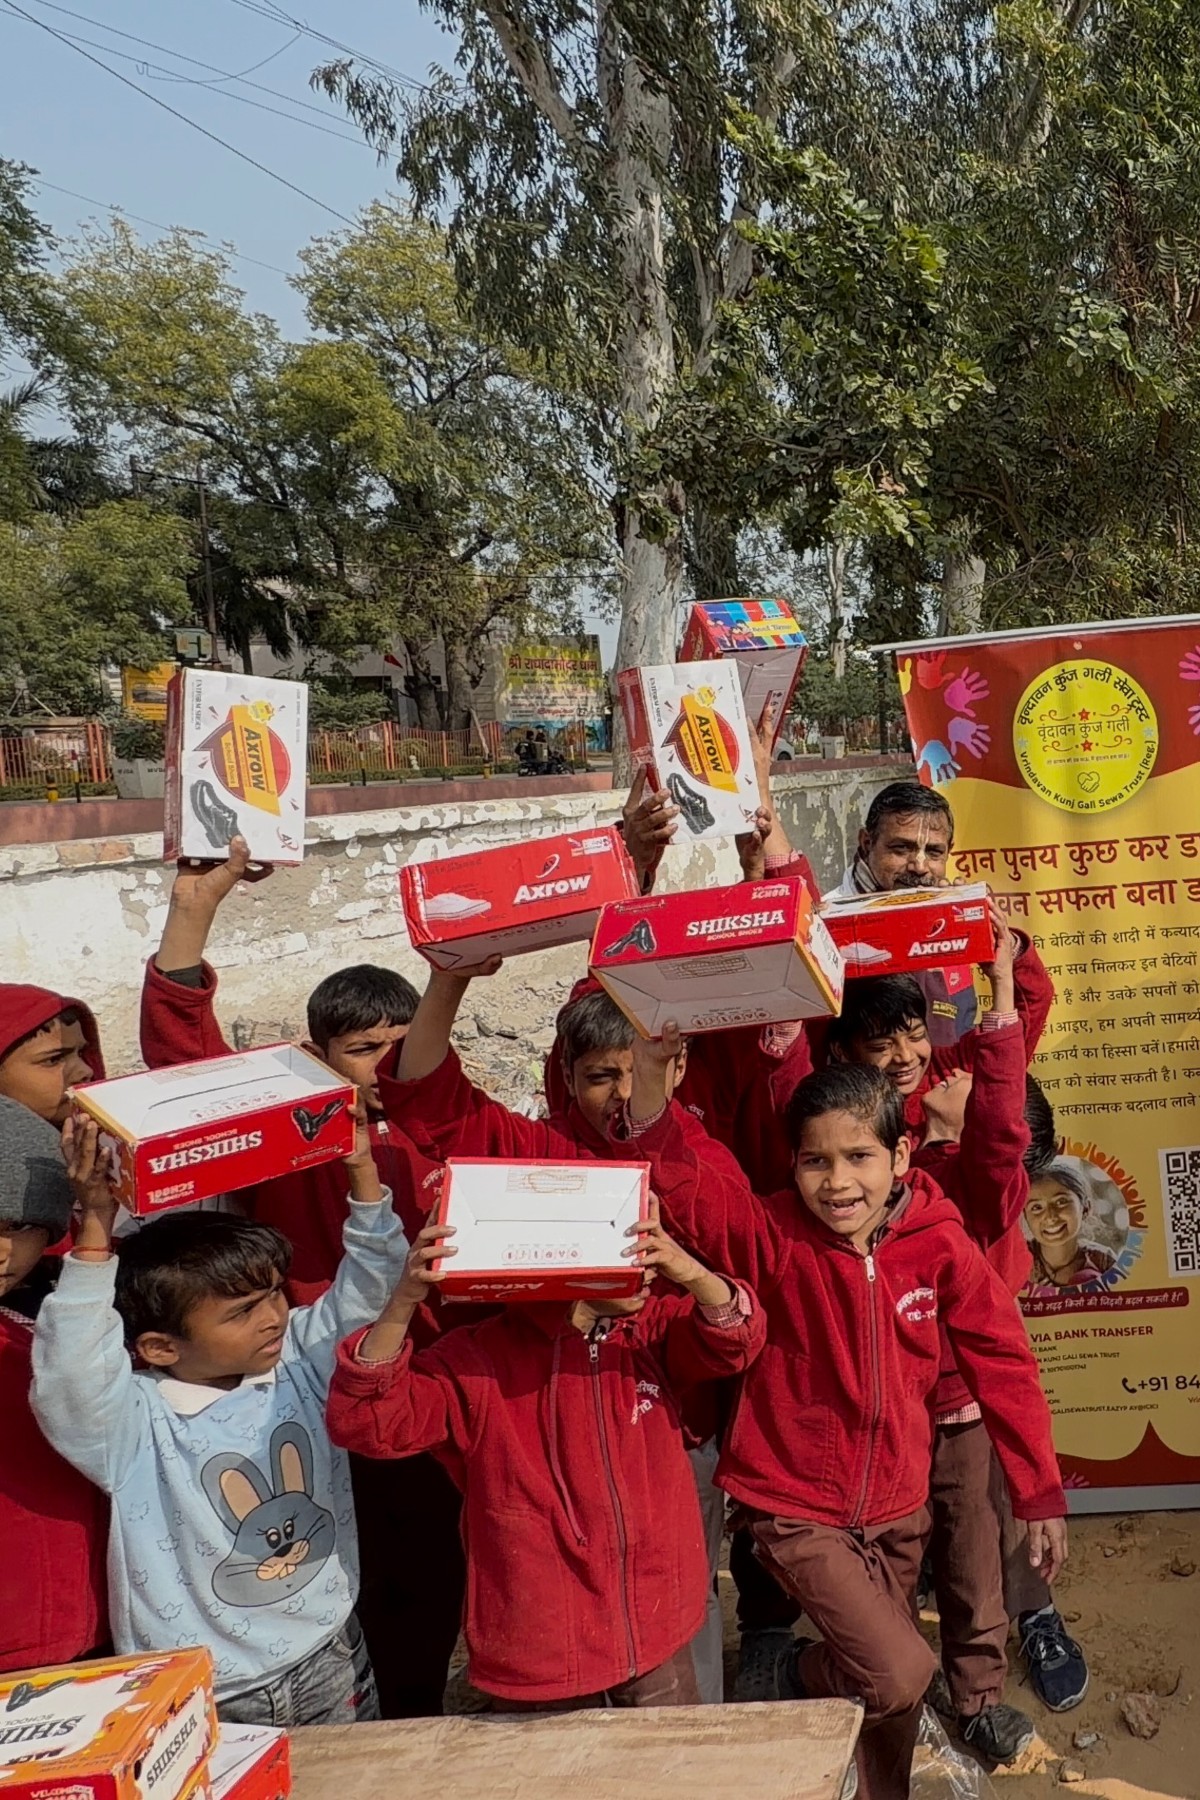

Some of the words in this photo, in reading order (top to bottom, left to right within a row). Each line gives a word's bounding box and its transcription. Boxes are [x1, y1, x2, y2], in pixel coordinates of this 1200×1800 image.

[1053, 668, 1079, 692] कुंज
[1083, 667, 1113, 684] गली
[1113, 676, 1136, 700] सेवा
[1037, 723, 1076, 742] वृंदावन
[1079, 721, 1103, 739] कुंज
[1106, 715, 1130, 733] गली
[695, 714, 723, 773] Axrow
[1020, 751, 1053, 797] Vrindavan
[1053, 792, 1075, 809] Kunj
[1098, 792, 1125, 808] Sewa
[1123, 770, 1145, 793] Trust
[950, 849, 997, 878] दान
[1000, 844, 1060, 881] पुनय
[1064, 839, 1120, 876] कुछ
[1124, 835, 1171, 861] कर
[513, 874, 592, 905] Axrow
[1035, 885, 1118, 914] सफल
[1121, 880, 1178, 906] बना
[685, 910, 786, 937] SHIKSHA
[1049, 930, 1086, 948] बेटियों
[1089, 929, 1107, 945] की
[1112, 926, 1141, 943] शादी
[1144, 924, 1157, 940] में
[908, 936, 969, 957] Axrow
[1066, 963, 1088, 975] सब
[1090, 958, 1137, 974] मिलकर
[1139, 957, 1158, 972] इन
[1161, 951, 1198, 967] बेटियों
[1063, 987, 1074, 1005] हैं
[1079, 986, 1102, 1002] और
[1106, 985, 1137, 1000] उनके
[1141, 981, 1177, 998] सपनों
[1182, 979, 1200, 995] को
[1097, 1018, 1116, 1031] हम
[1121, 1011, 1156, 1028] अपनी
[1051, 1045, 1079, 1061] कार्य
[1081, 1047, 1099, 1059] का
[1101, 1043, 1137, 1059] हिस्सा
[1064, 1073, 1082, 1088] को
[1085, 1072, 1117, 1087] संवार
[1120, 1068, 1158, 1085] सकती
[1058, 1102, 1122, 1116] सकारात्मक
[1125, 1098, 1168, 1113] बदलाव
[1170, 1092, 1196, 1108] लाने
[147, 1130, 262, 1174] SHIKSHA
[1030, 1333, 1051, 1343] VIA
[1054, 1329, 1089, 1341] BANK
[1091, 1325, 1154, 1338] TRANSFER
[1138, 1376, 1168, 1392] +91
[146, 1713, 198, 1789] SHIKSHA
